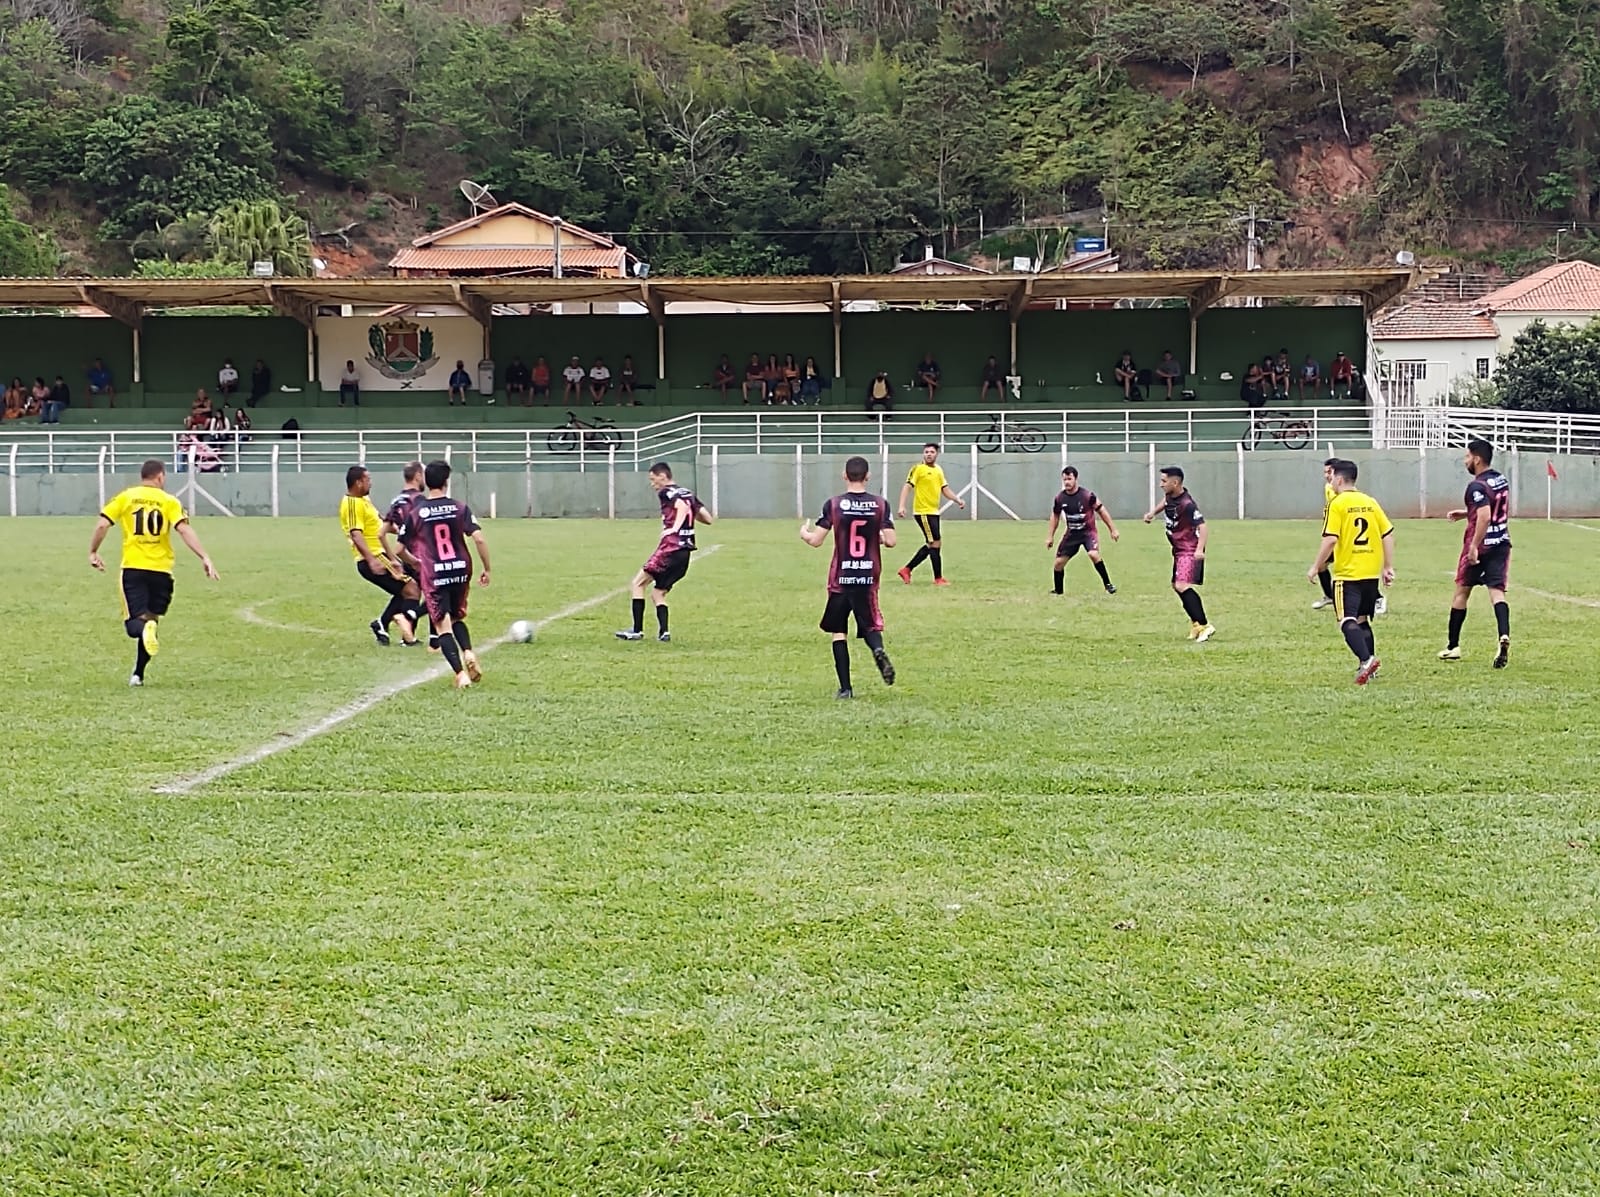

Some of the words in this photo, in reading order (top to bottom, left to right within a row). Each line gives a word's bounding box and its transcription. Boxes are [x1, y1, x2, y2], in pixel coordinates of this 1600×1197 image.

[131, 507, 163, 536] 10
[1353, 517, 1369, 546] 2
[434, 523, 456, 561] 8
[849, 519, 868, 558] 6
